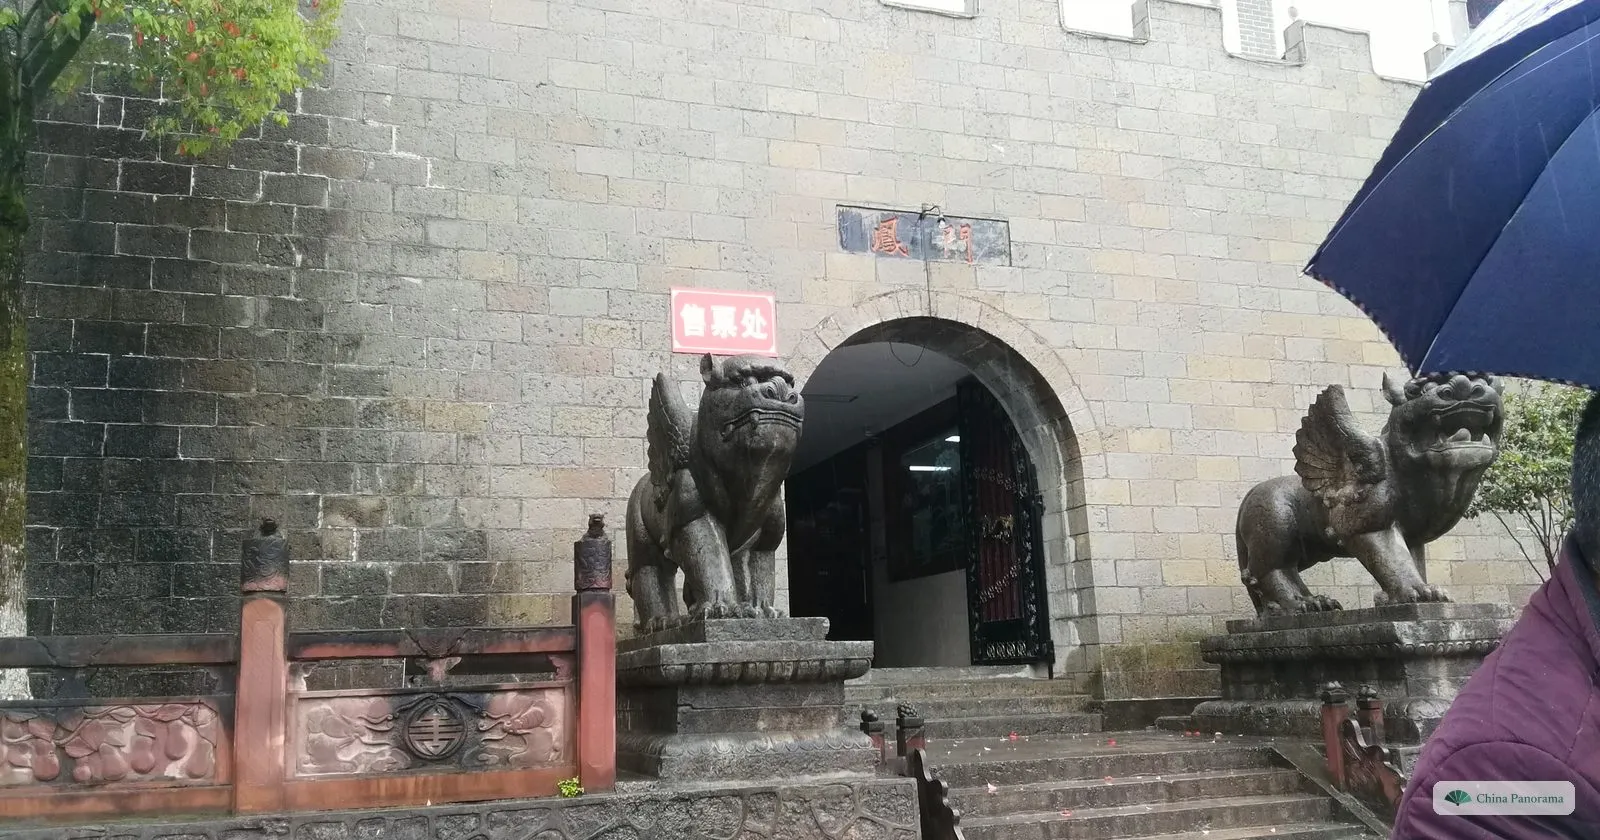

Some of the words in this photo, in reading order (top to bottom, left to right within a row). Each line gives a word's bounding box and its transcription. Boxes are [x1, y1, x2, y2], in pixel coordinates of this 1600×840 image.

[871, 216, 973, 264] 鳳門
[680, 303, 768, 339] 售票处
